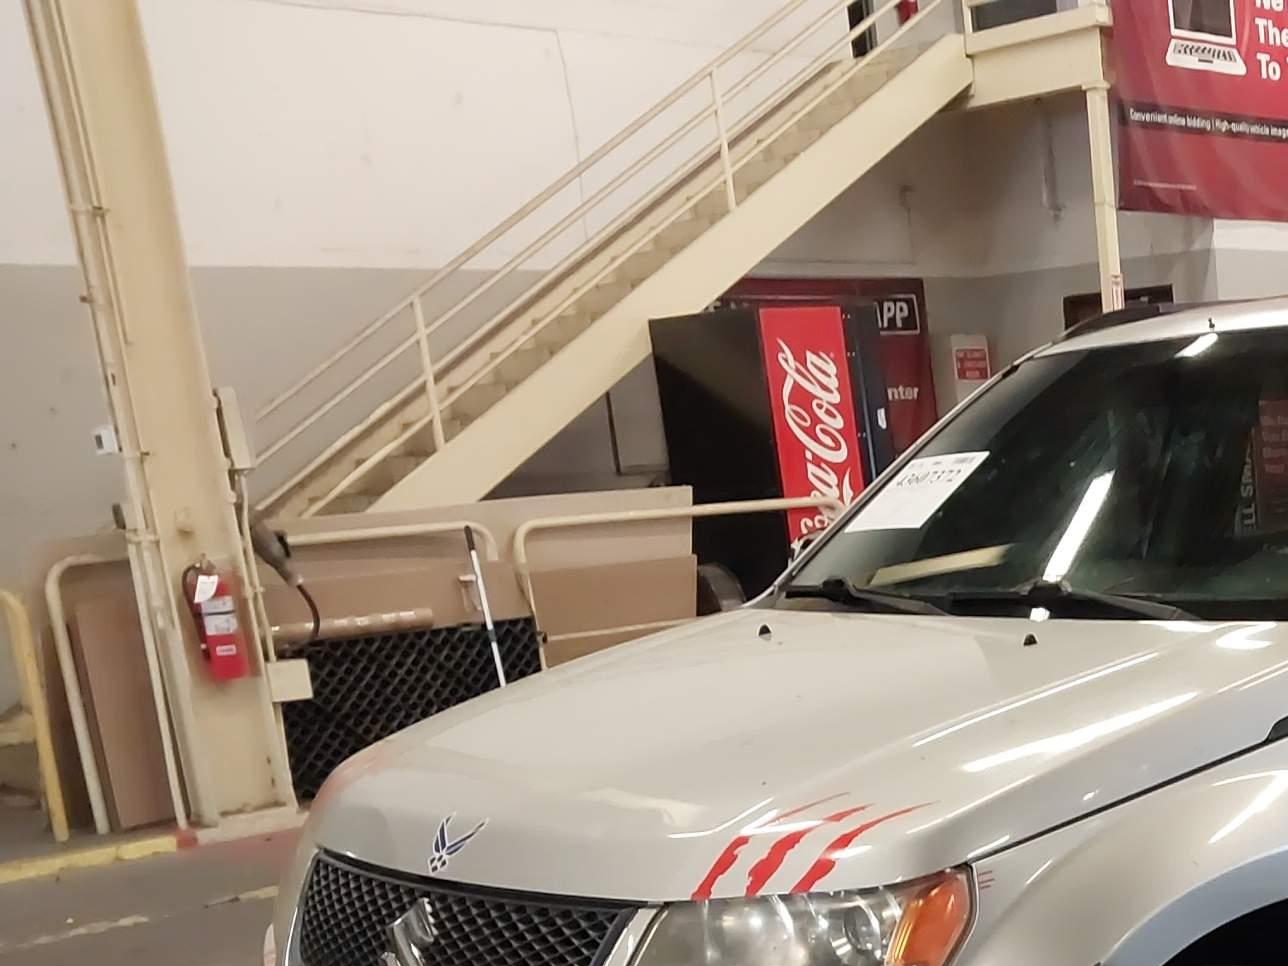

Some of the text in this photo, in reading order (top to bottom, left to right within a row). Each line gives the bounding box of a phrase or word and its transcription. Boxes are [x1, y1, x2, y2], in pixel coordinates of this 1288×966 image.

[1256, 52, 1281, 81] To
[1130, 107, 1168, 123] Convenient
[886, 385, 919, 401] nter
